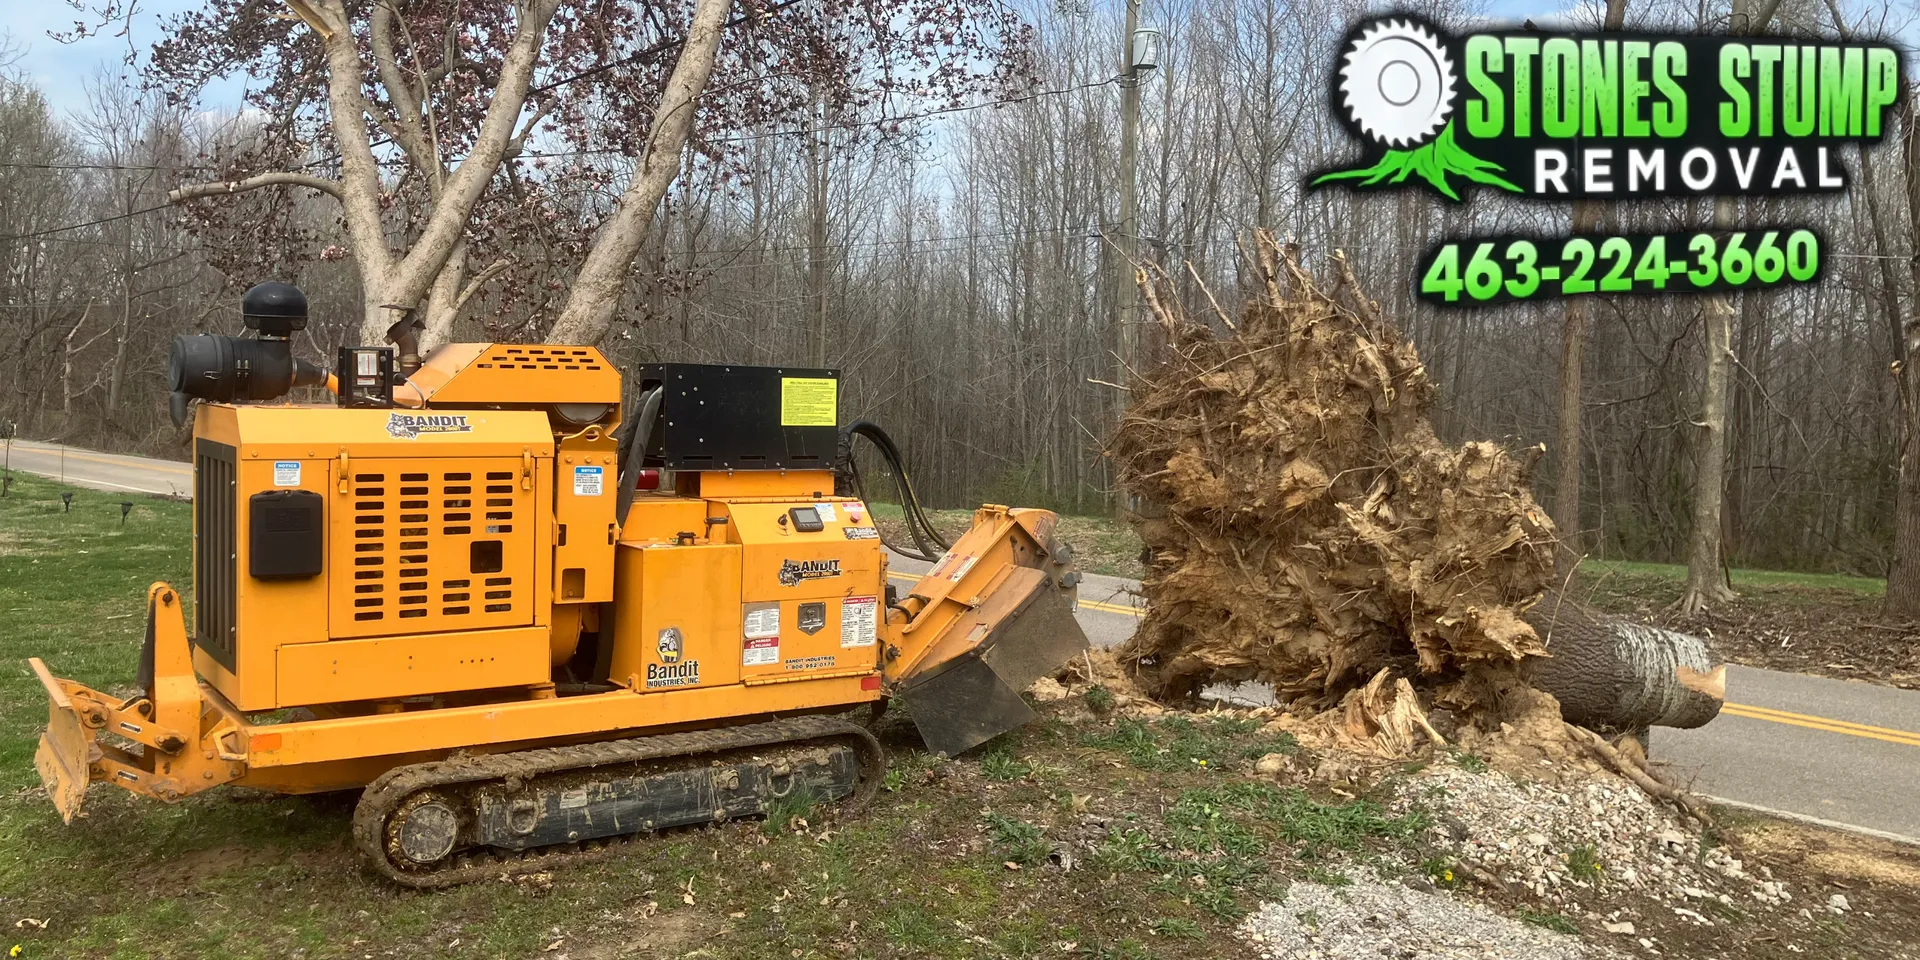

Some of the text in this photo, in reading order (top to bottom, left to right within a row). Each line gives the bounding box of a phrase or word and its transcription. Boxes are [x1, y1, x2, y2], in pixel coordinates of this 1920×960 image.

[402, 415, 467, 426] BANDIT
[792, 559, 840, 571] BANDIT
[647, 660, 699, 680] Bandit
[646, 676, 701, 688] INDUSTRIES, INC.
